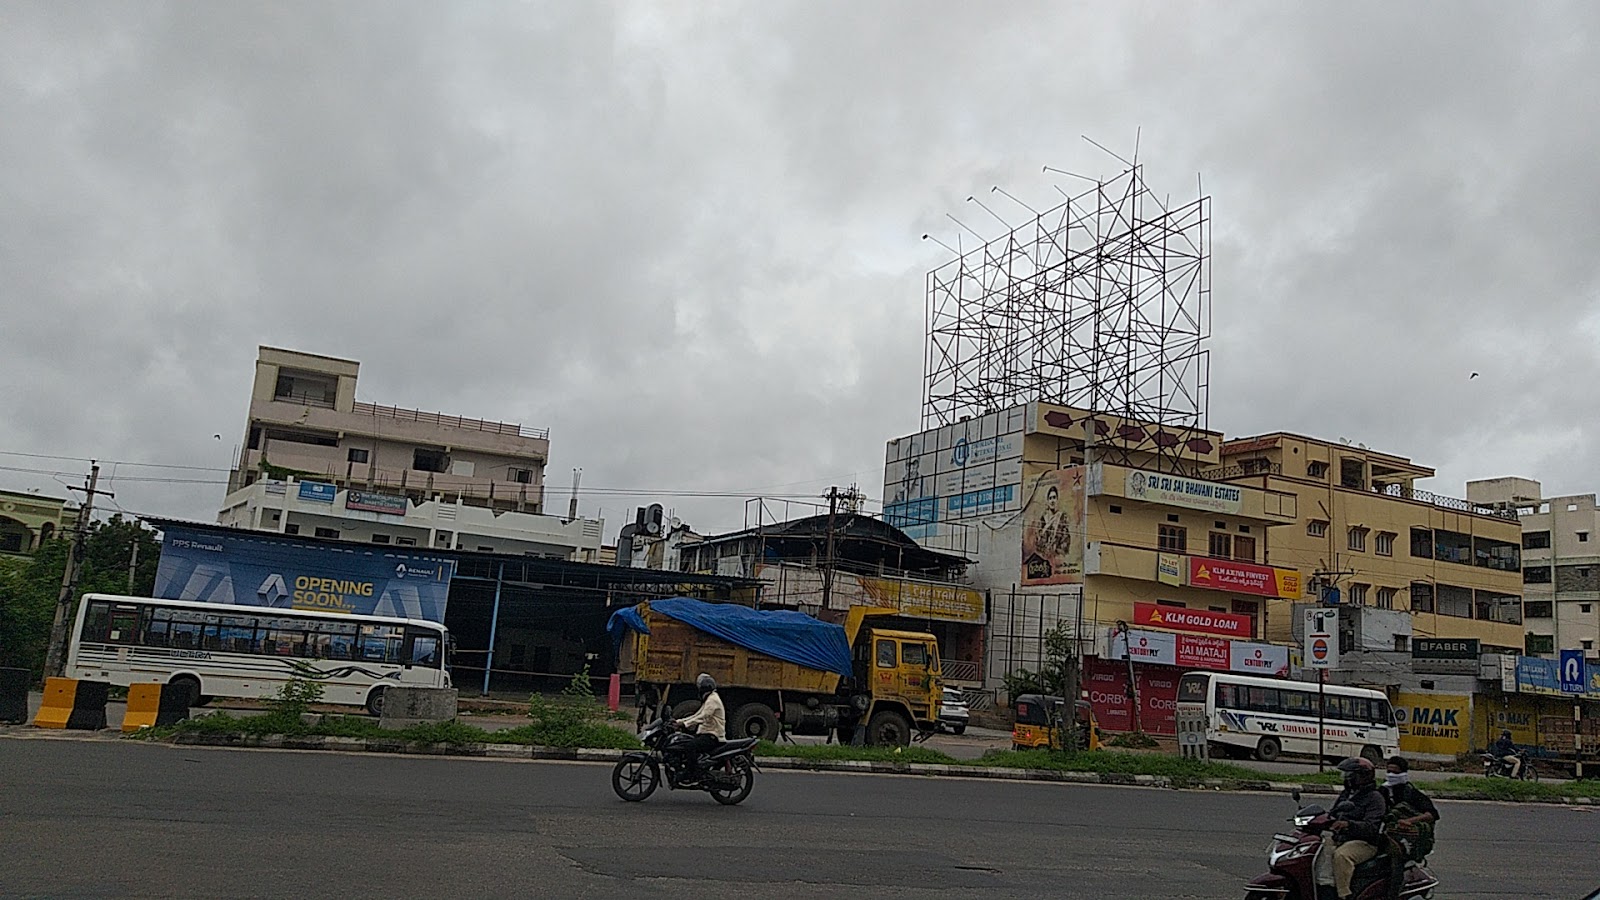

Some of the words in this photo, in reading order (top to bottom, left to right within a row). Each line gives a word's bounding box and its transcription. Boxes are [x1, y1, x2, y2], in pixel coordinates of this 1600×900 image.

[971, 443, 1012, 458] INTERNAONAL
[1148, 475, 1160, 490] SRI
[1160, 477, 1172, 492] SRI
[1173, 479, 1184, 493] SAI
[1185, 481, 1213, 498] BHAVANI
[1214, 486, 1240, 502] ESTATES
[172, 539, 190, 549] PPS
[191, 541, 224, 552] Renault
[408, 567, 434, 575] RENAULT
[1212, 566, 1226, 576] KLM
[1245, 570, 1269, 581] FINVEST
[295, 576, 374, 596] OPENING
[292, 590, 356, 609] SOON...
[912, 585, 967, 602] CHAITANYA
[1164, 612, 1185, 625] KLM
[1186, 615, 1212, 627] GOLD
[1213, 618, 1238, 630] LOAN
[1128, 646, 1160, 657] CENTURYPLY
[1179, 645, 1194, 655] JAI
[1195, 646, 1227, 659] MATAJI
[1429, 642, 1468, 651] FABER
[1244, 658, 1274, 669] CENTURYPLY
[1091, 673, 1115, 682] VIRGO
[1149, 679, 1172, 688] VIRGO
[1562, 684, 1568, 692] U
[1569, 684, 1584, 692] TURN
[1090, 690, 1128, 705] CORBY
[1149, 697, 1178, 710] CORB
[1412, 707, 1459, 727] MAK
[1257, 721, 1278, 733] VRL
[1412, 726, 1460, 739] LUBRICANTS
